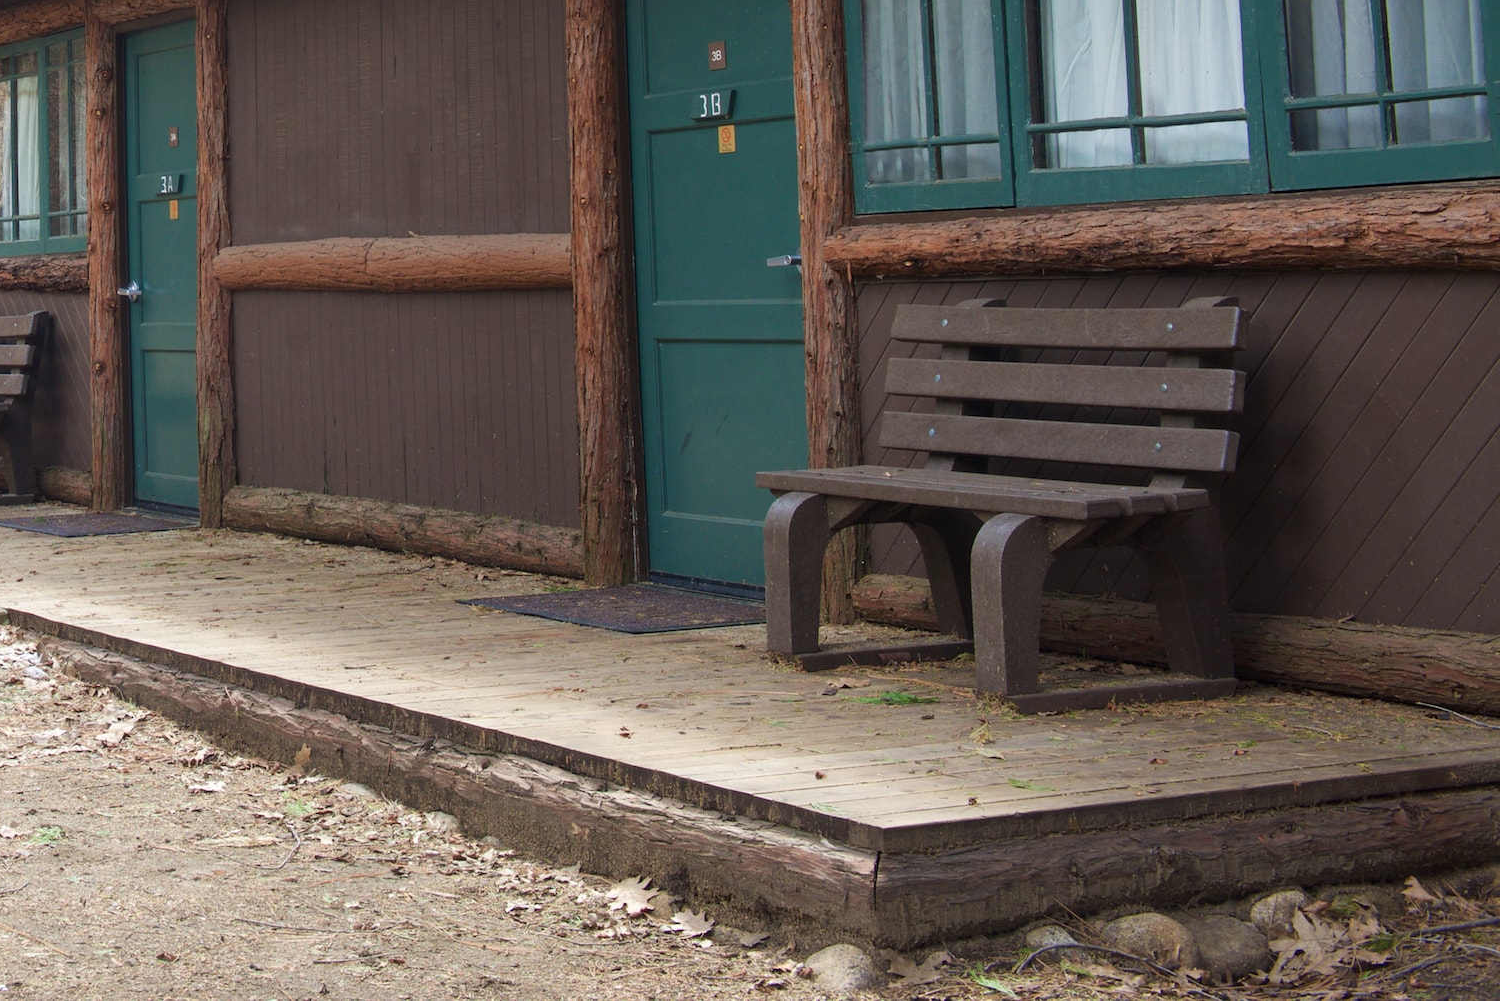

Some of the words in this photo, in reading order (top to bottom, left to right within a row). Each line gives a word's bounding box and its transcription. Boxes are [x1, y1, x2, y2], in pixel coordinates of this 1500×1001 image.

[711, 49, 722, 62] 3B
[699, 92, 721, 118] 3B
[160, 175, 174, 194] 3A
